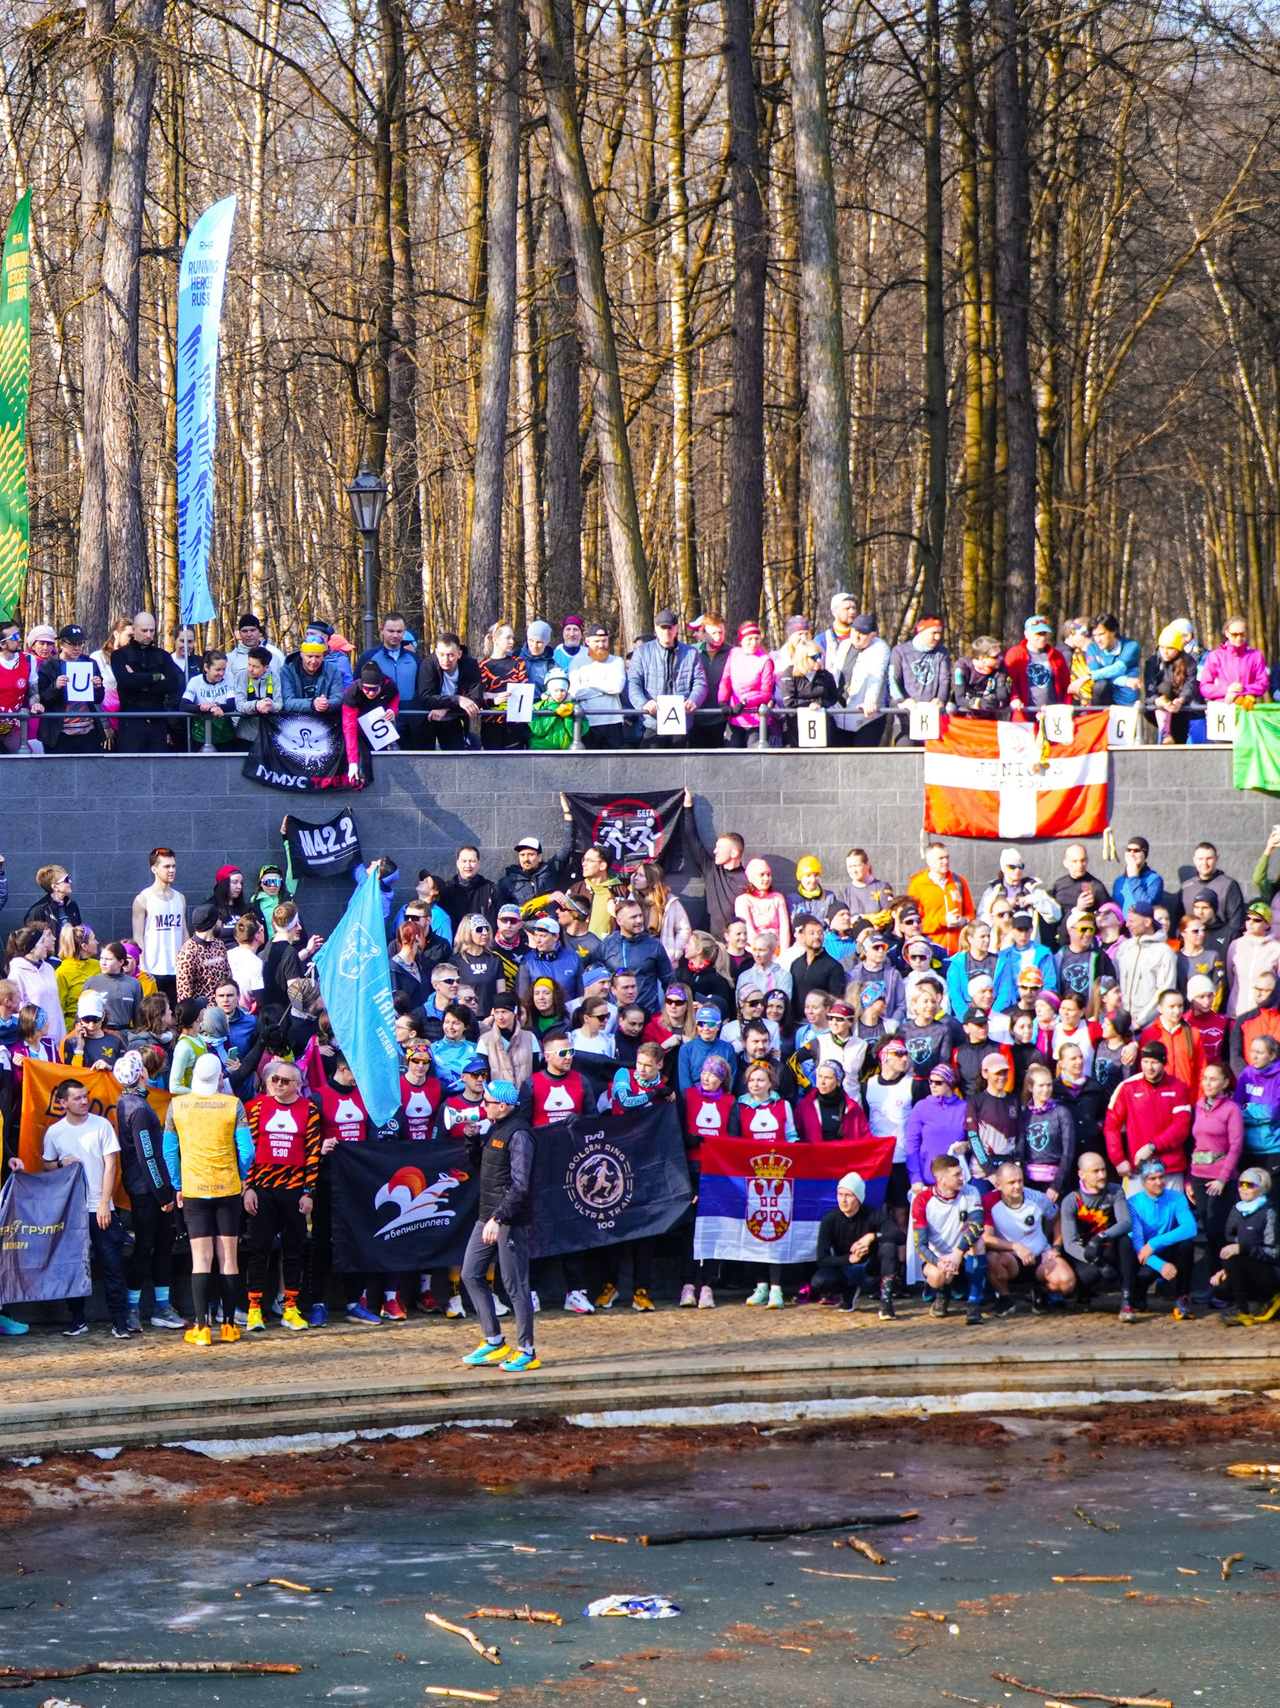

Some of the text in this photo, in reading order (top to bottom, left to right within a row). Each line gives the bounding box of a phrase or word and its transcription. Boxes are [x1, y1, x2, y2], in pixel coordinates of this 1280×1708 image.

[188, 259, 219, 275] RUNNING
[72, 673, 90, 692] U
[663, 706, 681, 725] A
[371, 719, 389, 739] S
[256, 764, 308, 788] ГУМУС
[637, 809, 654, 818] БЕГА
[298, 816, 358, 857] M42.2
[155, 914, 181, 927] M42.2
[272, 1148, 288, 1157] 5:00
[568, 1143, 626, 1170] GOLDEN RING
[574, 1192, 633, 1220] ULTRA TRAIL
[596, 1220, 615, 1230] 100
